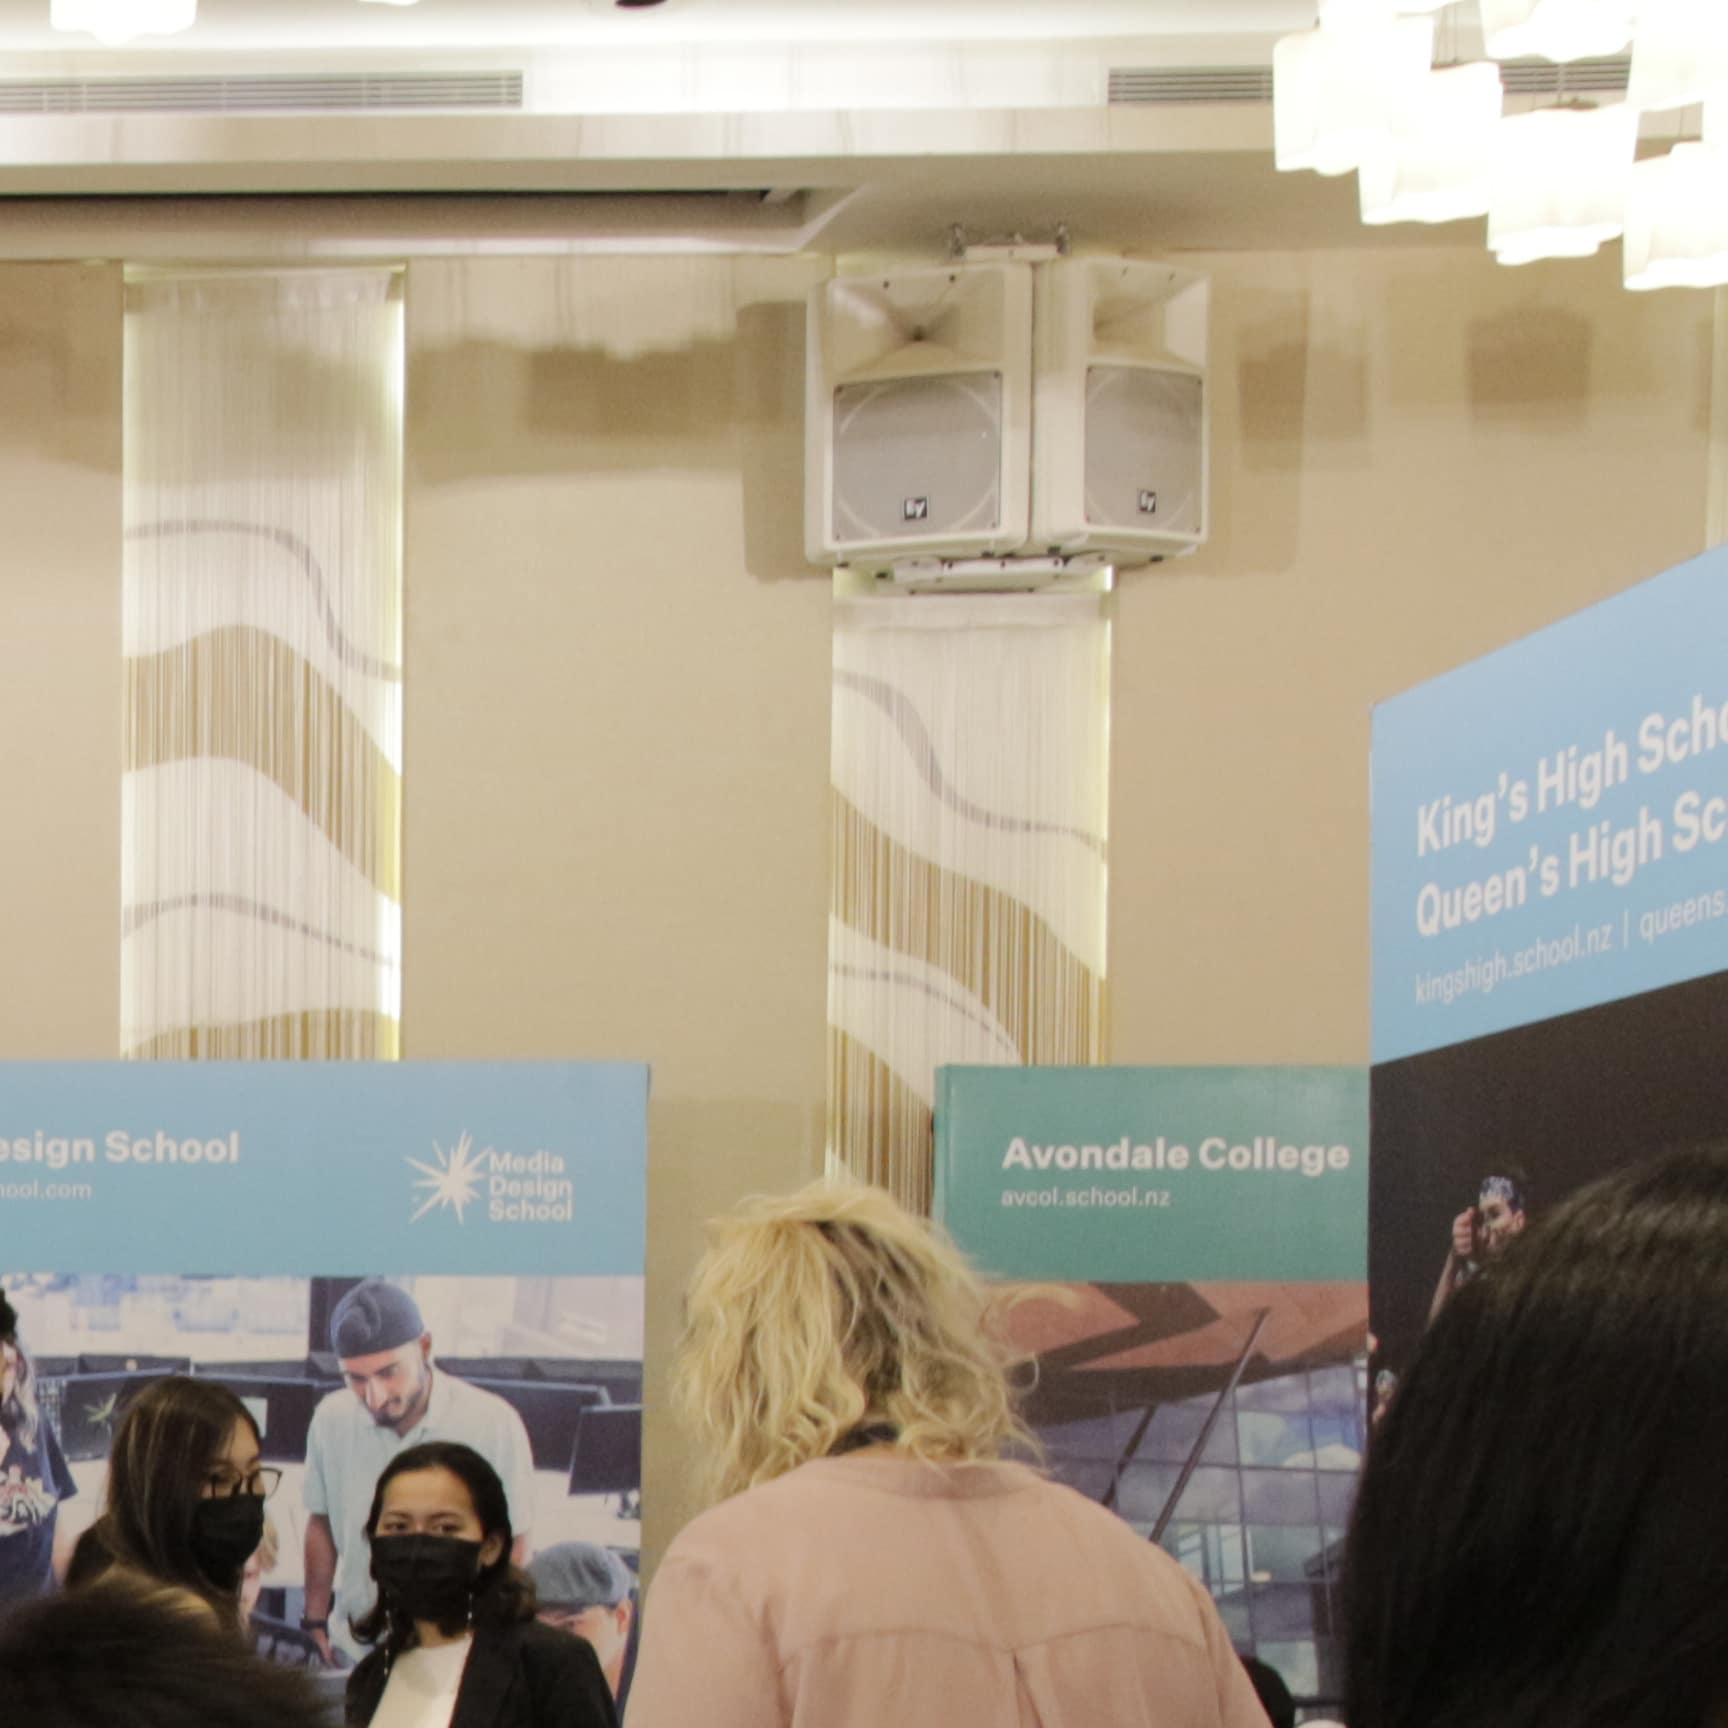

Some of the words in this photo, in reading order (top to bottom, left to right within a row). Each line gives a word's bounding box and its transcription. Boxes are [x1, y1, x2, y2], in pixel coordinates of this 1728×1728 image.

[1417, 771, 1528, 857] King's
[1536, 729, 1628, 813] High
[1637, 692, 1728, 773] Sch
[1416, 844, 1560, 937] Queen's
[1569, 805, 1663, 888] High
[1415, 922, 1614, 1005] kingshigh.school.nz
[105, 1130, 240, 1163] School
[489, 1149, 565, 1173] Media
[1002, 1136, 1190, 1170] Avondale
[1199, 1136, 1350, 1177] College
[489, 1174, 573, 1202] Design
[1001, 1186, 1171, 1209] avcol.school.nz
[489, 1199, 573, 1222] School
